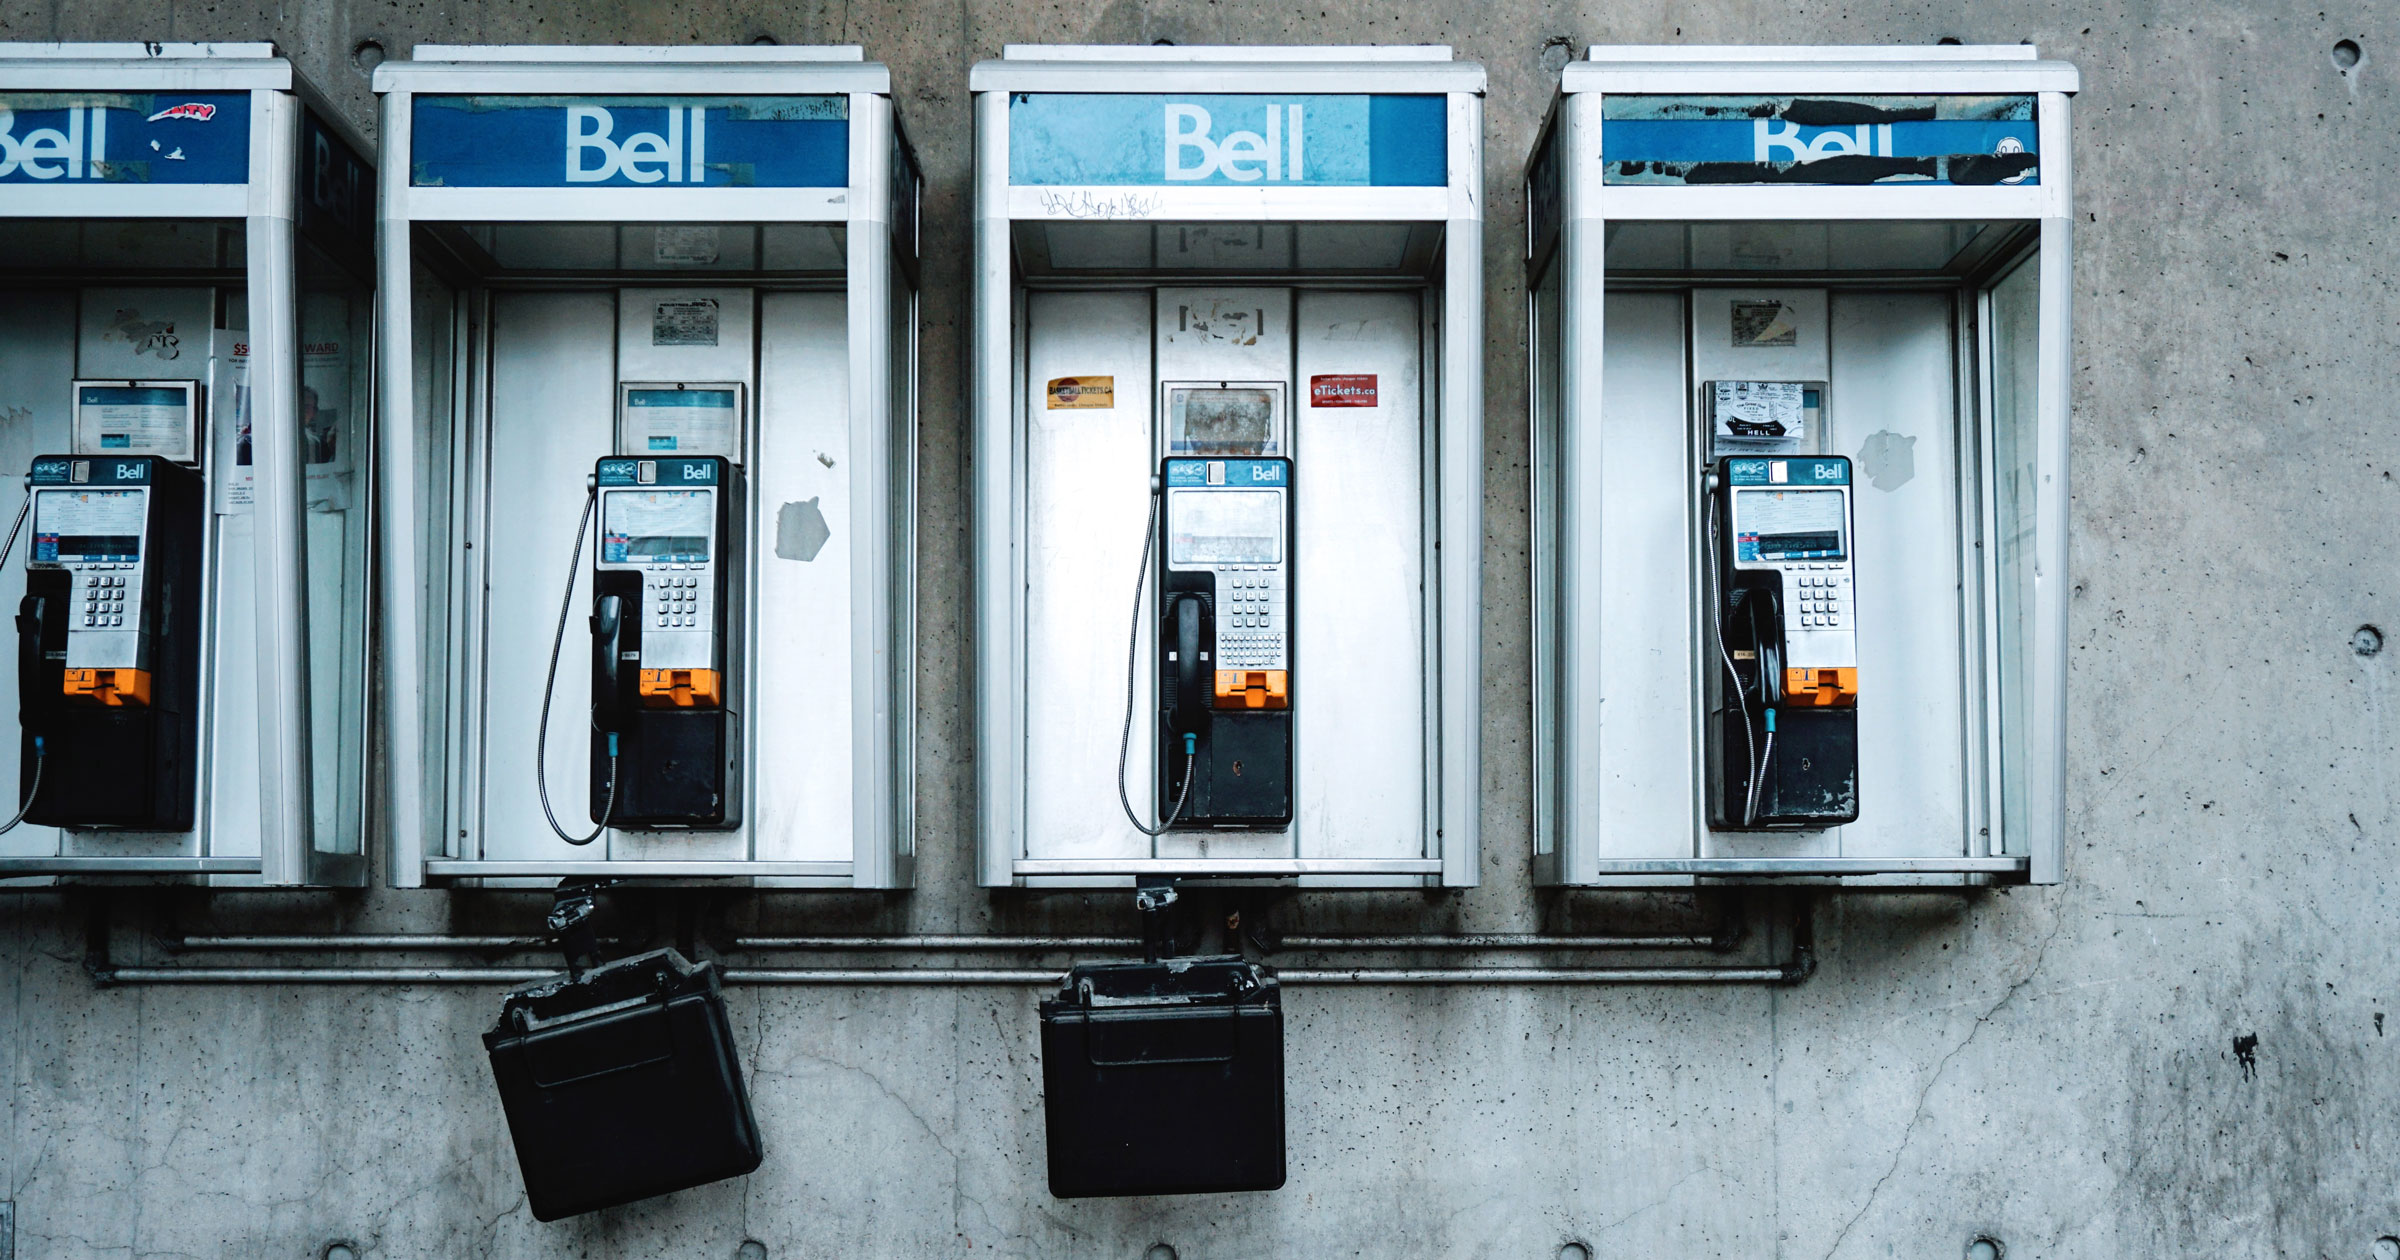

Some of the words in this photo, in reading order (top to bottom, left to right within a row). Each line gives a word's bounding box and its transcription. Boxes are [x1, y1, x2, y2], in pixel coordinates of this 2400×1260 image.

[162, 103, 214, 119] NTY
[565, 105, 705, 183] Bell
[1164, 103, 1303, 182] Bell
[233, 342, 250, 355] $5
[304, 342, 339, 353] WARD
[117, 463, 145, 480] Bell
[683, 464, 711, 480] Bell
[1252, 465, 1280, 481] Bell
[1814, 464, 1842, 480] Bell
